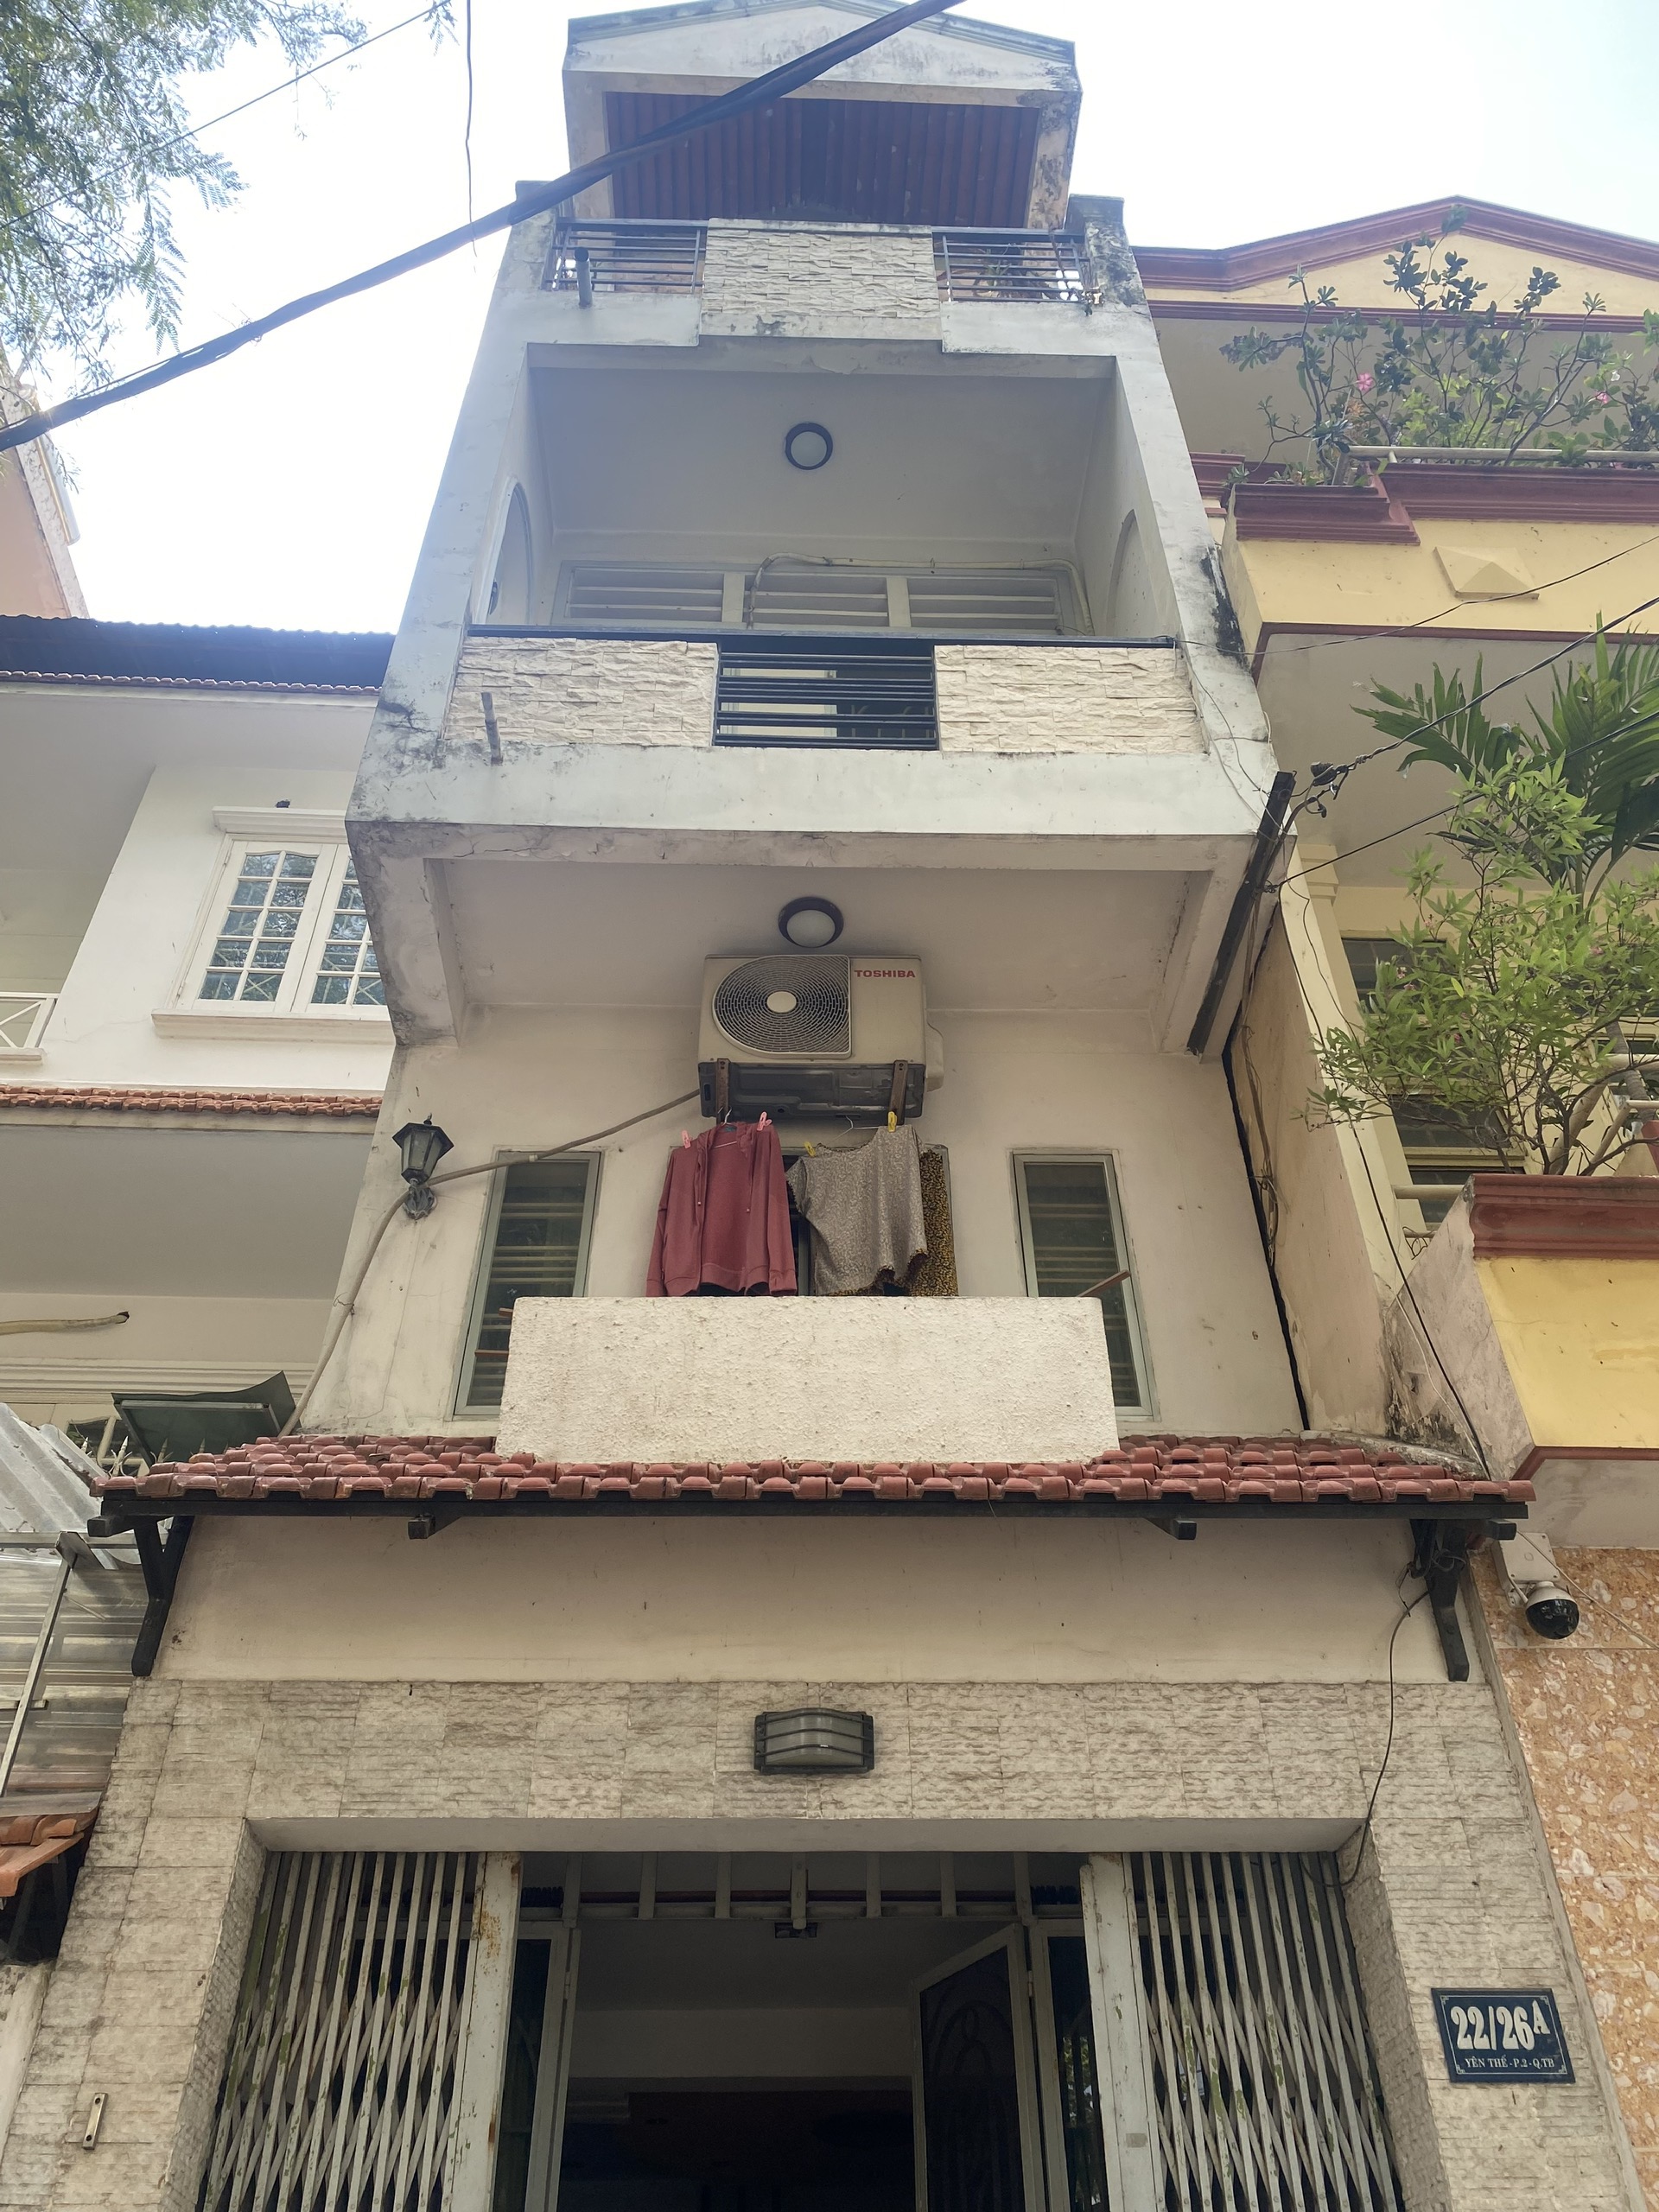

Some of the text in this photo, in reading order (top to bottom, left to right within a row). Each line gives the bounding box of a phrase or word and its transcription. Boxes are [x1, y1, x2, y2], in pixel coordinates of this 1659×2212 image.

[854, 969, 916, 978] TOSHIBA
[1450, 1999, 1551, 2050] 22/26A
[1465, 2056, 1485, 2068] YÊN
[1487, 2054, 1509, 2068] THẾ
[1532, 2057, 1554, 2069] Q.TB
